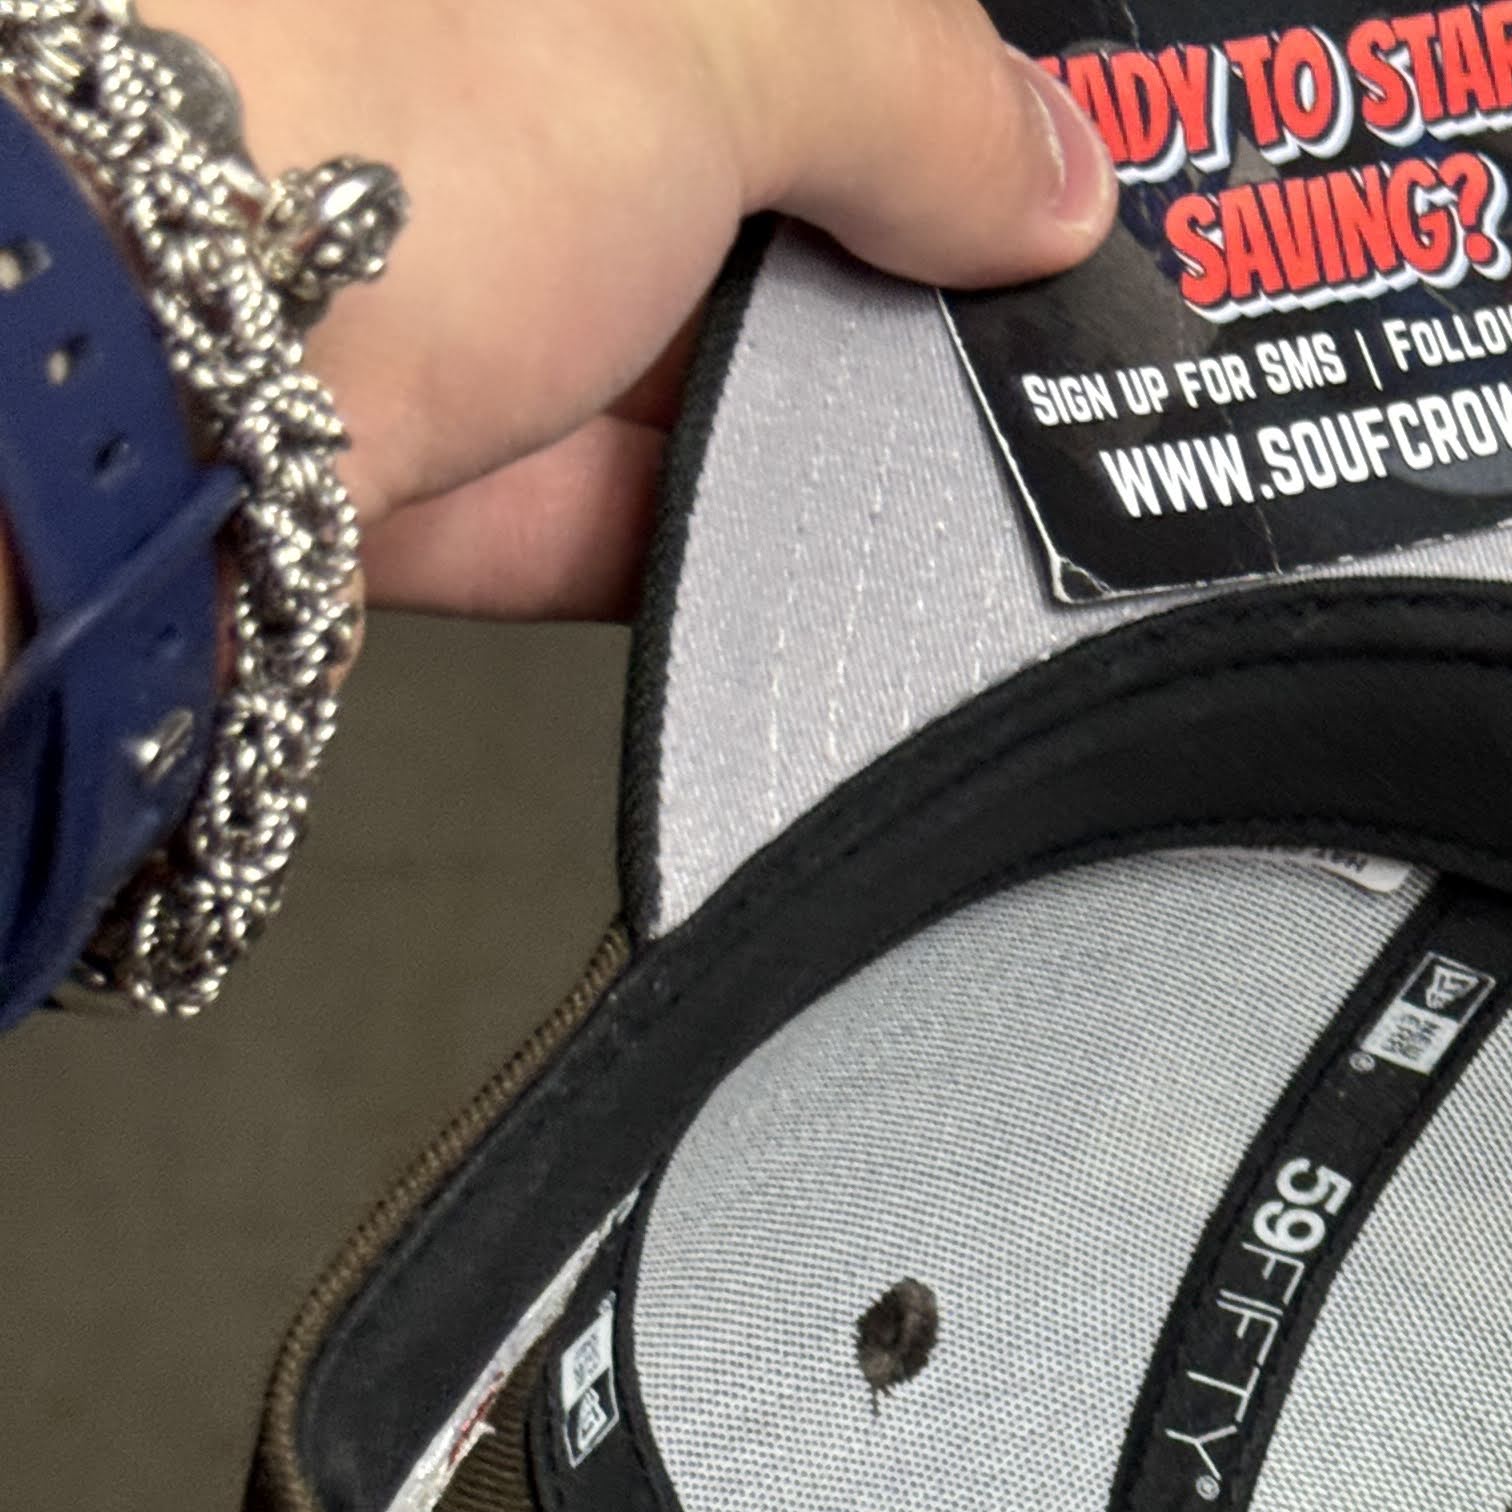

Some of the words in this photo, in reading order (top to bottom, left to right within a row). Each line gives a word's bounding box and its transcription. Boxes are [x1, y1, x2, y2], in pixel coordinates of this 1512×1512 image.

[1036, 44, 1224, 178] ADY
[1223, 26, 1347, 162] TO
[1165, 152, 1508, 320] SAVING?
[1022, 373, 1118, 426] SIGN
[1116, 366, 1169, 416] UP
[1173, 354, 1257, 409] FOR
[1255, 332, 1347, 395] SMS
